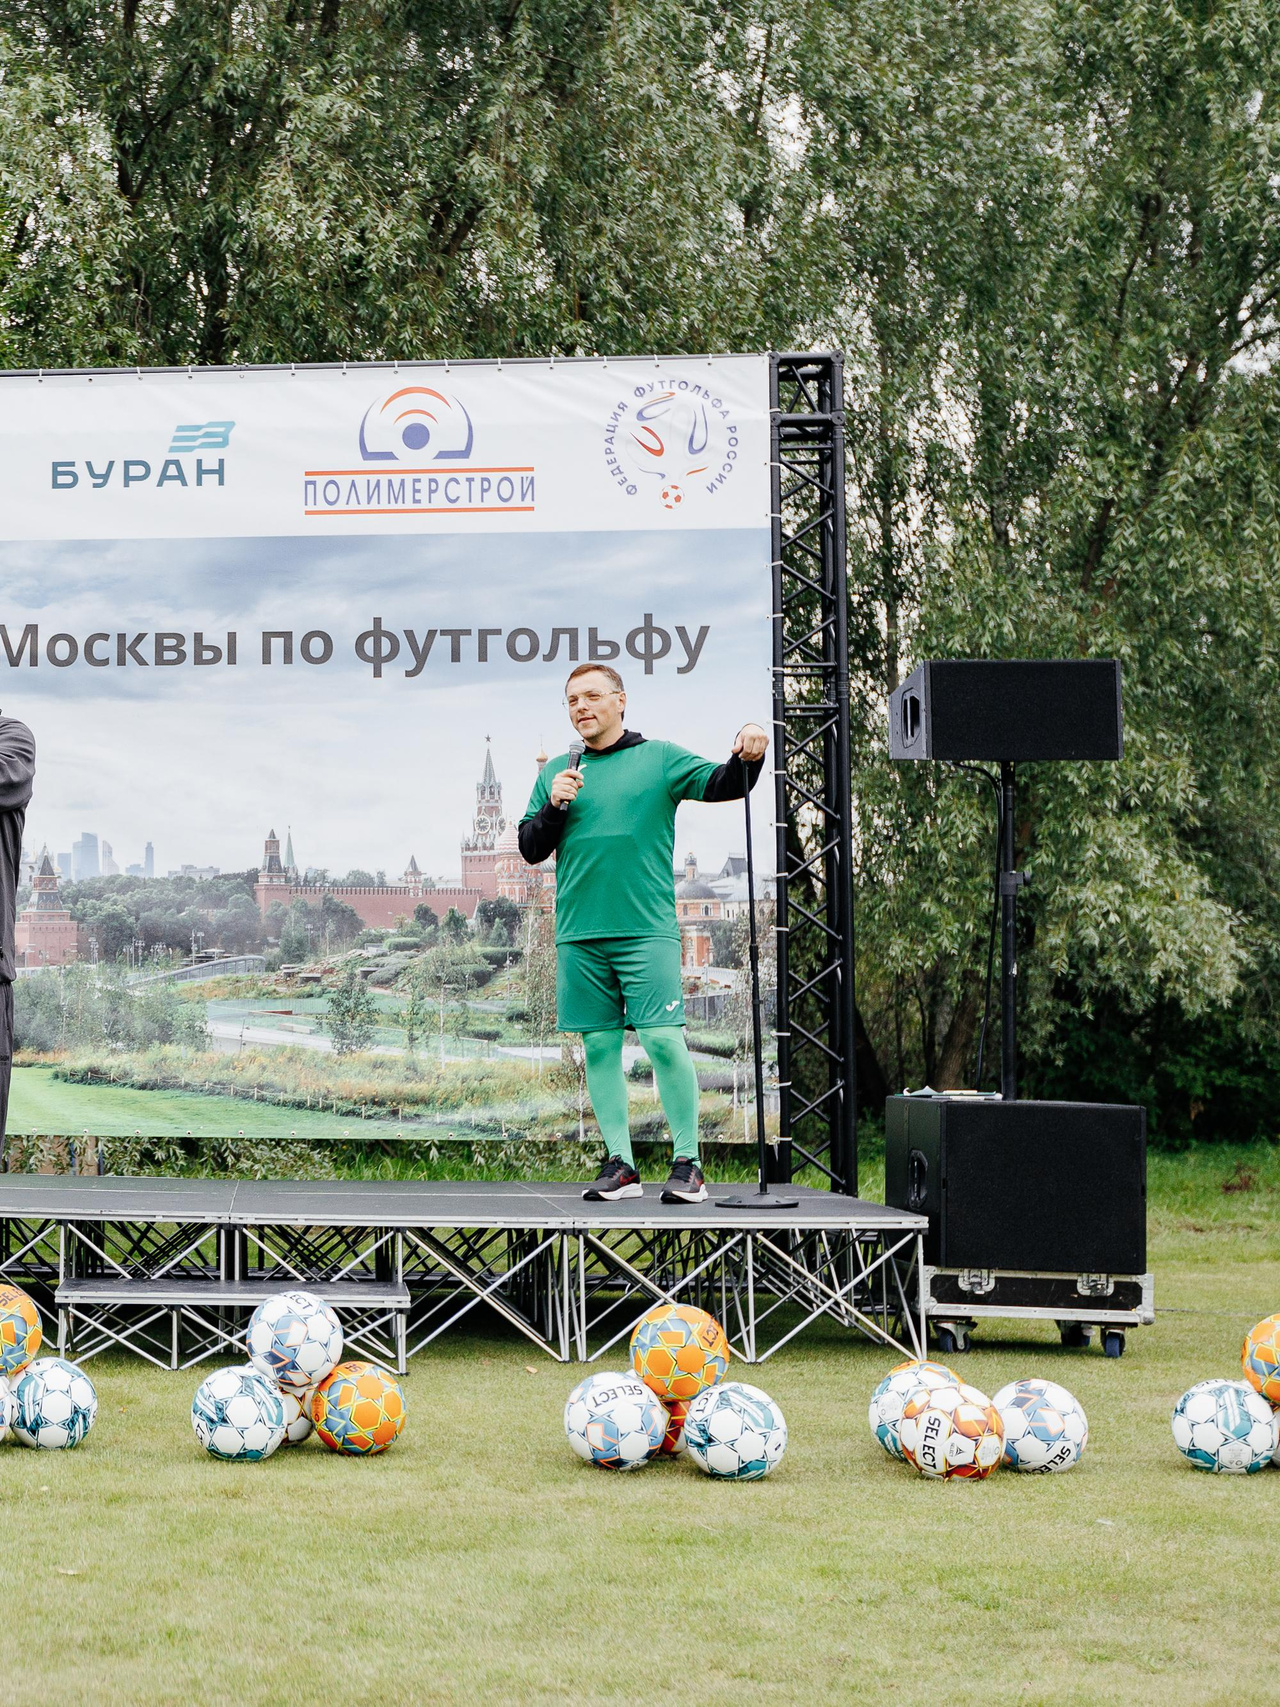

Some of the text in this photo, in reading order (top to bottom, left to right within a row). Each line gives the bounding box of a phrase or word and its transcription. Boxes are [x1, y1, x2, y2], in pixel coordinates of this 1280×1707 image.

[604, 380, 738, 495] ФЕДЕРАЦИЯ ФУТГОЛЬФА РОССИИ
[51, 458, 225, 489] БУРАН
[304, 475, 535, 506] ПОЛИМЕРСТРОЙ
[261, 629, 334, 665] по
[354, 613, 711, 678] футгольфу
[592, 1384, 643, 1408] SELECT
[922, 1416, 941, 1470] SELECT
